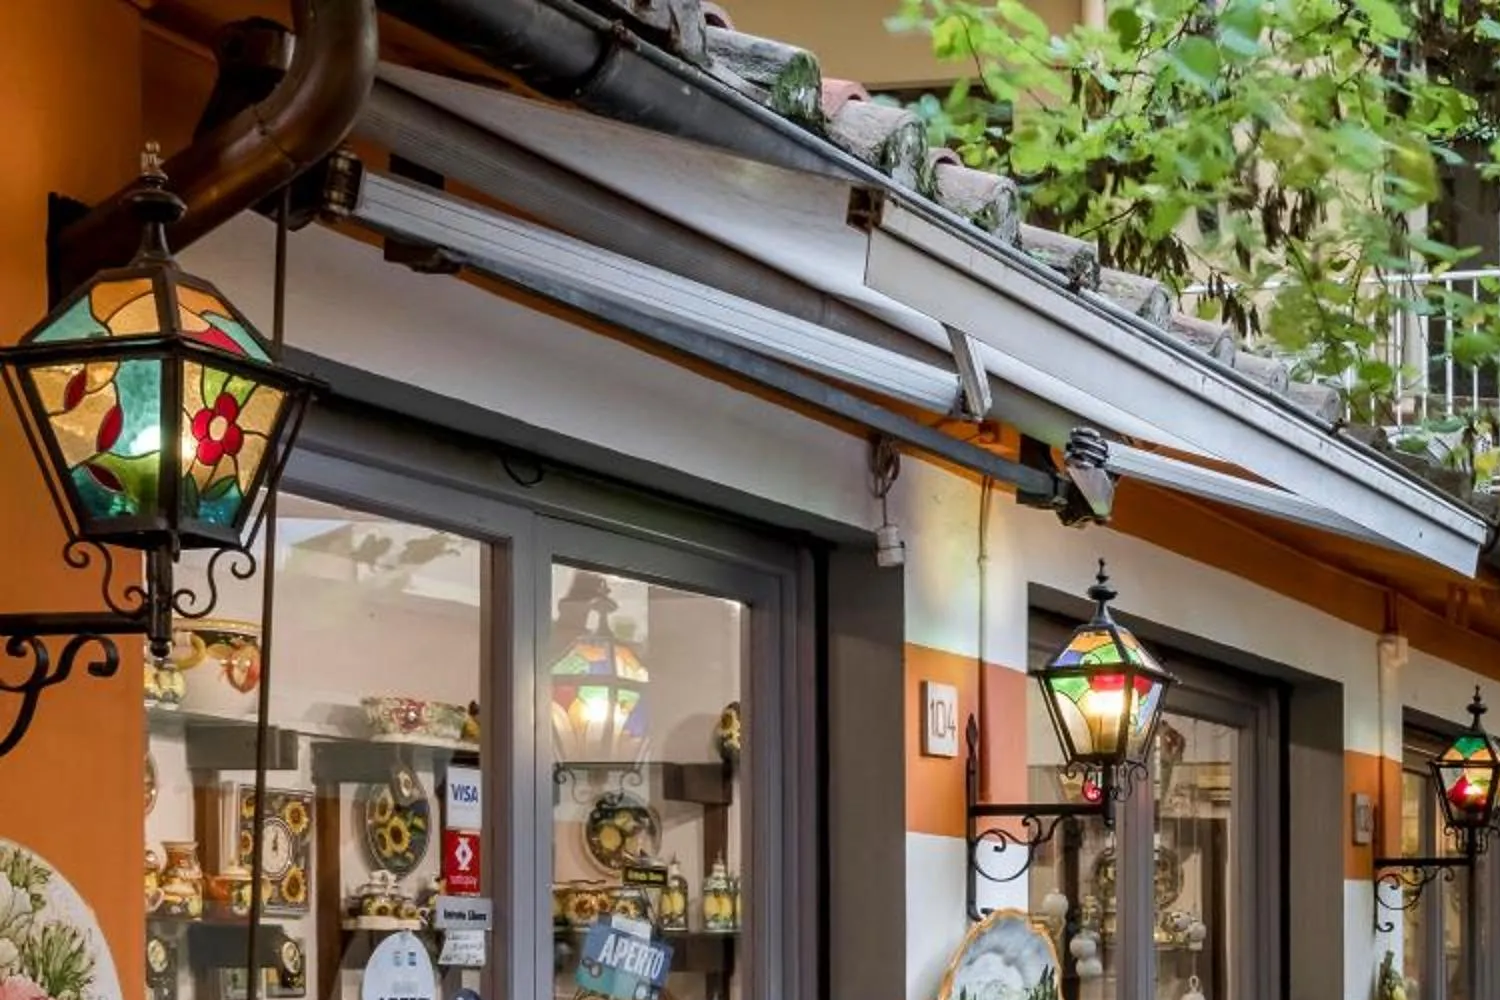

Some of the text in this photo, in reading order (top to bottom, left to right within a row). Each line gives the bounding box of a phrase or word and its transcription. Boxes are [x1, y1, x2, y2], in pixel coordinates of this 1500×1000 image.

[930, 698, 956, 740] 104
[451, 783, 479, 802] VISA
[597, 932, 666, 979] APERTO
